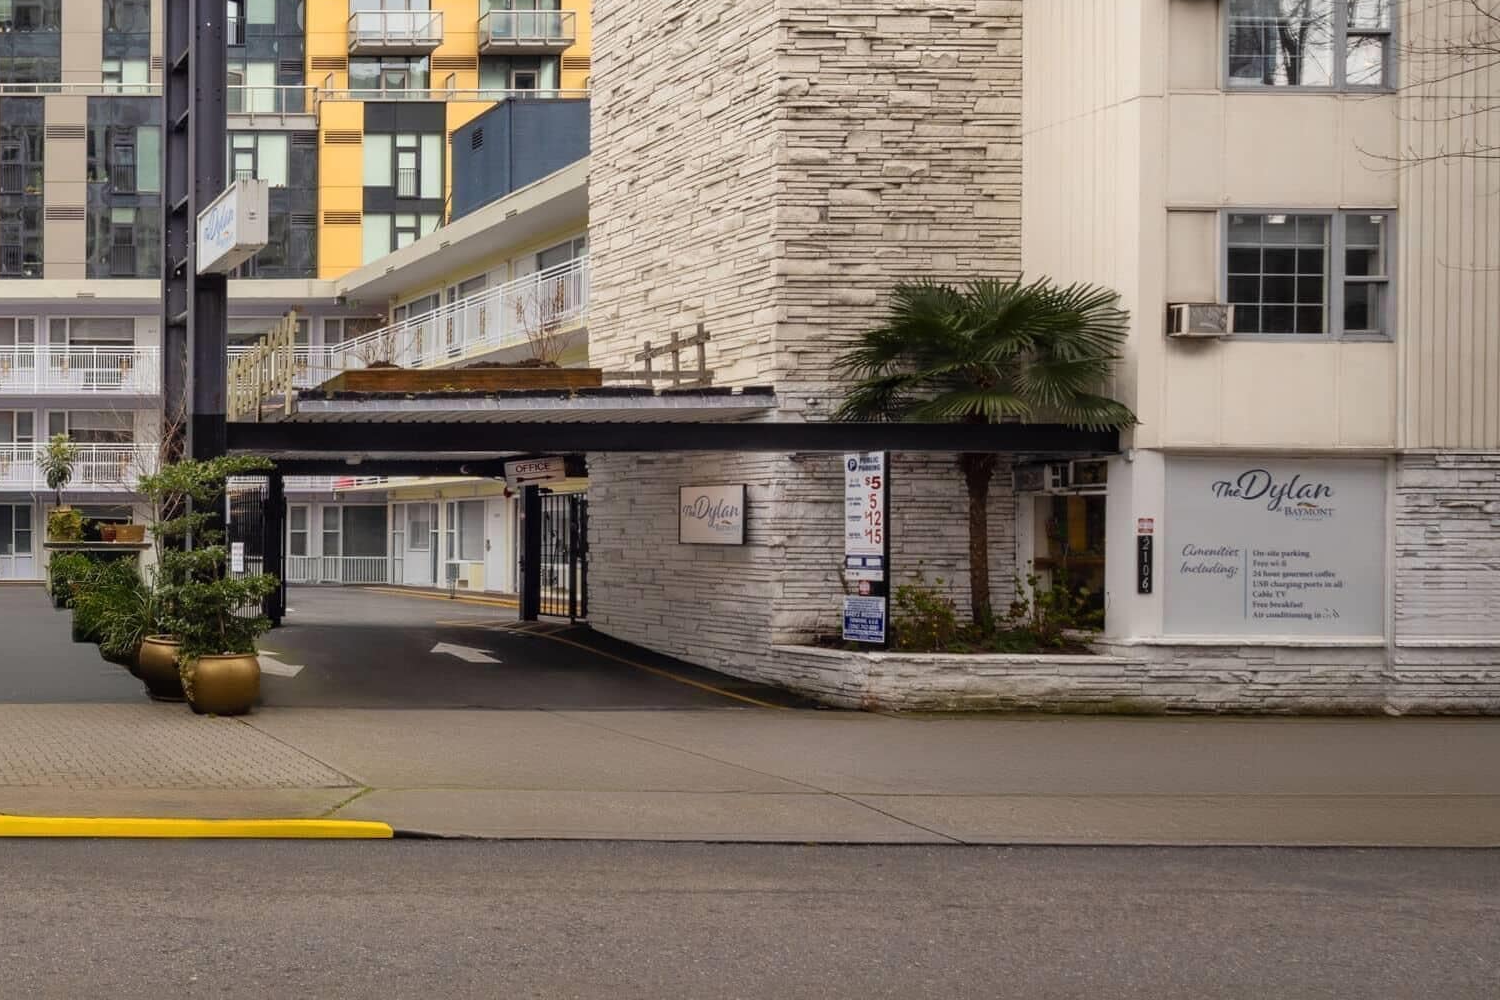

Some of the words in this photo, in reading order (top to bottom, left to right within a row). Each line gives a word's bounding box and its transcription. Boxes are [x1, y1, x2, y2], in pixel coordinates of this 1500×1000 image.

[515, 462, 550, 473] OFFICE
[865, 476, 881, 490] $5
[1211, 481, 1240, 498] The
[1237, 469, 1333, 511] Dylan
[693, 495, 740, 528] Dylan
[1284, 507, 1334, 517] BAYMONT
[1181, 544, 1239, 558] Amenities
[1281, 550, 1310, 559] parking
[1141, 538, 1150, 589] 2106
[1180, 561, 1239, 579] Including:
[1282, 571, 1313, 579] gourmet
[1270, 580, 1302, 589] charging
[1303, 581, 1323, 589] ports
[1333, 580, 1343, 588] all
[1266, 611, 1312, 620] conditioning
